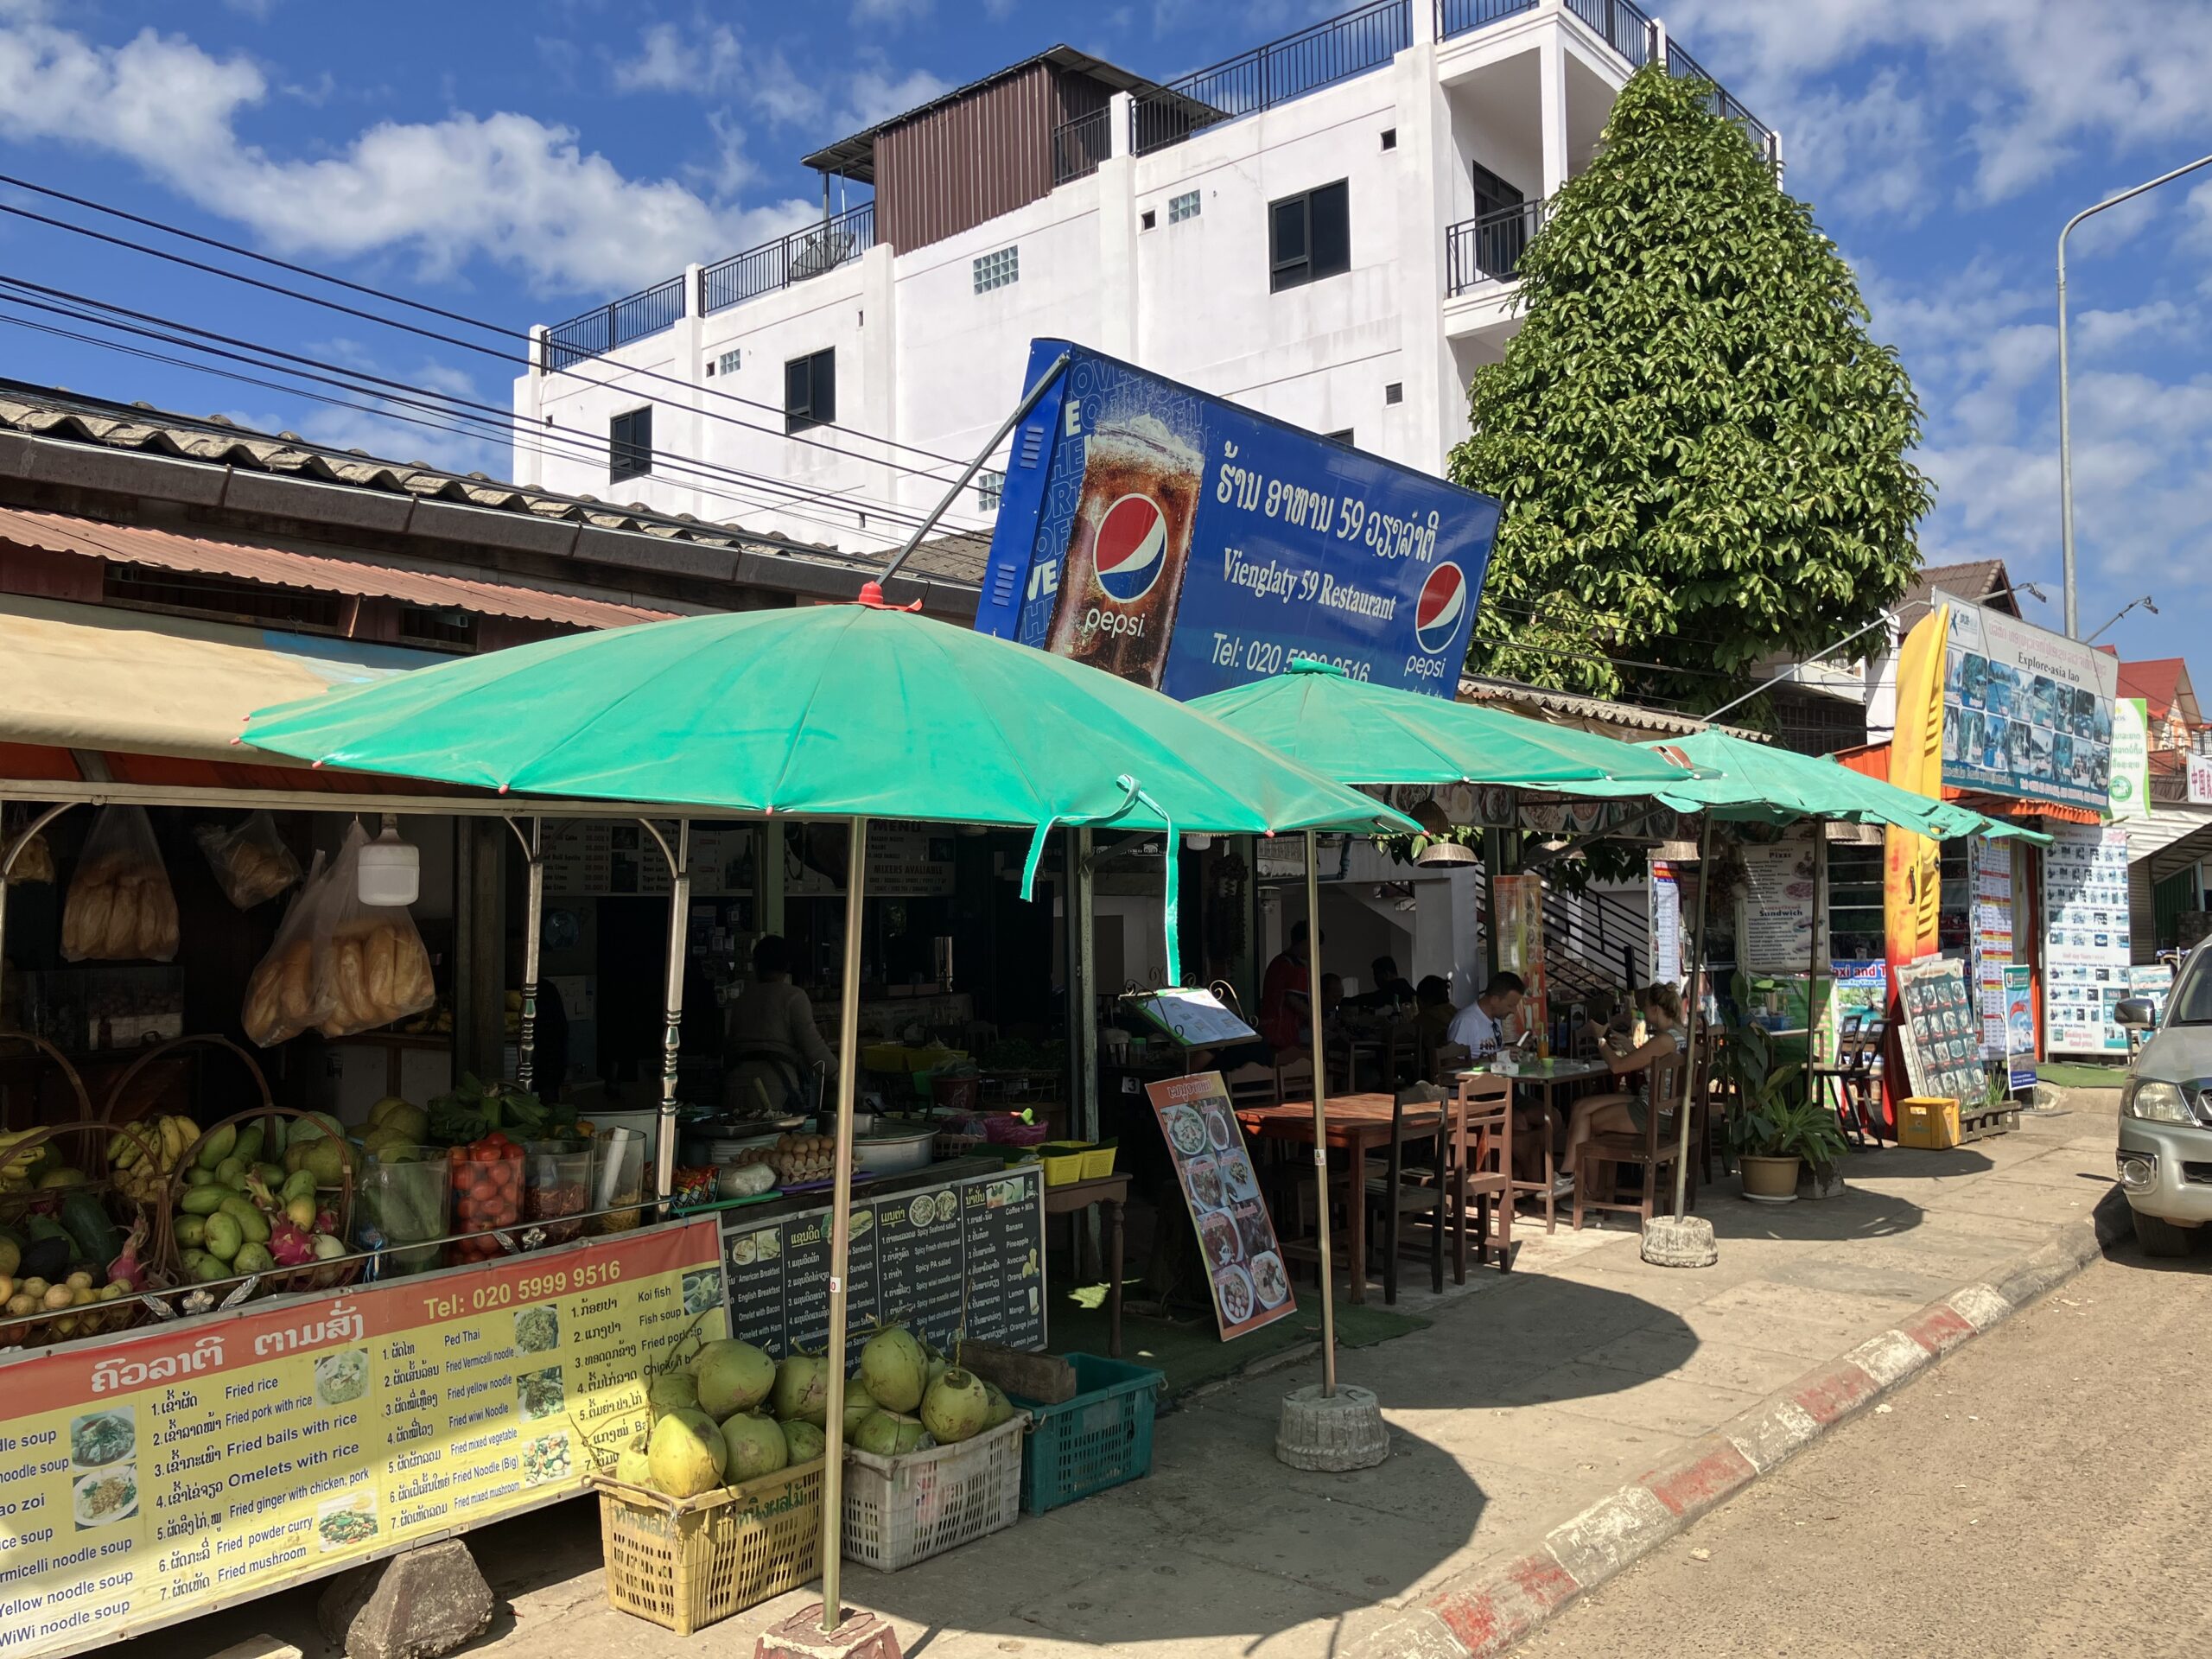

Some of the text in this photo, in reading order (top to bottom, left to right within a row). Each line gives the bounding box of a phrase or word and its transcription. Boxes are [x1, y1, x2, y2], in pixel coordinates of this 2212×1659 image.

[1337, 497, 1365, 541] 59
[1224, 547, 1394, 620] Vienglaty 59 Restaurant
[1085, 607, 1145, 639] pepsi
[1211, 632, 1243, 667] Tel:
[1246, 641, 1281, 674] 020
[1403, 654, 1446, 680] pepsi
[2018, 652, 2080, 683] Explore-asia lao
[1830, 964, 1850, 977] axi
[1853, 964, 1877, 977] and
[1025, 1203, 1034, 1212] Milk
[1006, 1223, 1023, 1232] Banana
[852, 1243, 873, 1255] Sandwich
[1006, 1237, 1029, 1249] Pineapple
[849, 1261, 873, 1274] Sandwich
[915, 1257, 951, 1274] Spicy PA salad
[1007, 1255, 1027, 1265] Avocado
[739, 1266, 780, 1283] American Breakfast
[423, 1260, 620, 1319] Tel: 020 5999 9516
[639, 1286, 671, 1302] Koi fish
[738, 1284, 781, 1304] English Breakfast
[1007, 1288, 1024, 1299] Lemon
[639, 1308, 682, 1325] Fish soup
[739, 1310, 755, 1322] Omelet
[766, 1305, 780, 1315] Bacon
[1008, 1306, 1025, 1316] Mango
[739, 1323, 782, 1340] Omelet with Ham
[1009, 1317, 1038, 1332] Orange juice
[444, 1328, 480, 1347] Ped Thai
[641, 1338, 664, 1351] Fried
[1010, 1334, 1038, 1348] Lemon juice
[446, 1346, 514, 1373] Fried Vermicelli noodle
[226, 1376, 278, 1400] Fried rice
[448, 1375, 512, 1400] Fried yellow noodle
[226, 1395, 313, 1427] Fried pork with rice
[449, 1403, 509, 1428] Fried wiwi Noodle
[21, 1430, 56, 1446] soup
[227, 1413, 358, 1457] Fried bails with rice
[450, 1427, 518, 1456] Fried mixed vegetable
[40, 1458, 69, 1474] soup
[229, 1443, 359, 1487] Omelets with rice
[453, 1455, 518, 1484] Fried Noodle (Big)
[22, 1493, 45, 1511] zoi
[230, 1467, 370, 1519] Fried ginger with chicken, pork
[454, 1481, 520, 1510] Fried mixed mushroom
[21, 1527, 54, 1546] soup
[217, 1517, 313, 1554] Fried powder curry
[53, 1547, 97, 1570] noodle
[101, 1537, 132, 1555] soup
[219, 1545, 307, 1582] Fried mushroom
[48, 1581, 94, 1605] noodle
[99, 1571, 133, 1589] soup
[41, 1611, 90, 1635] noodle
[94, 1600, 130, 1619] soup
